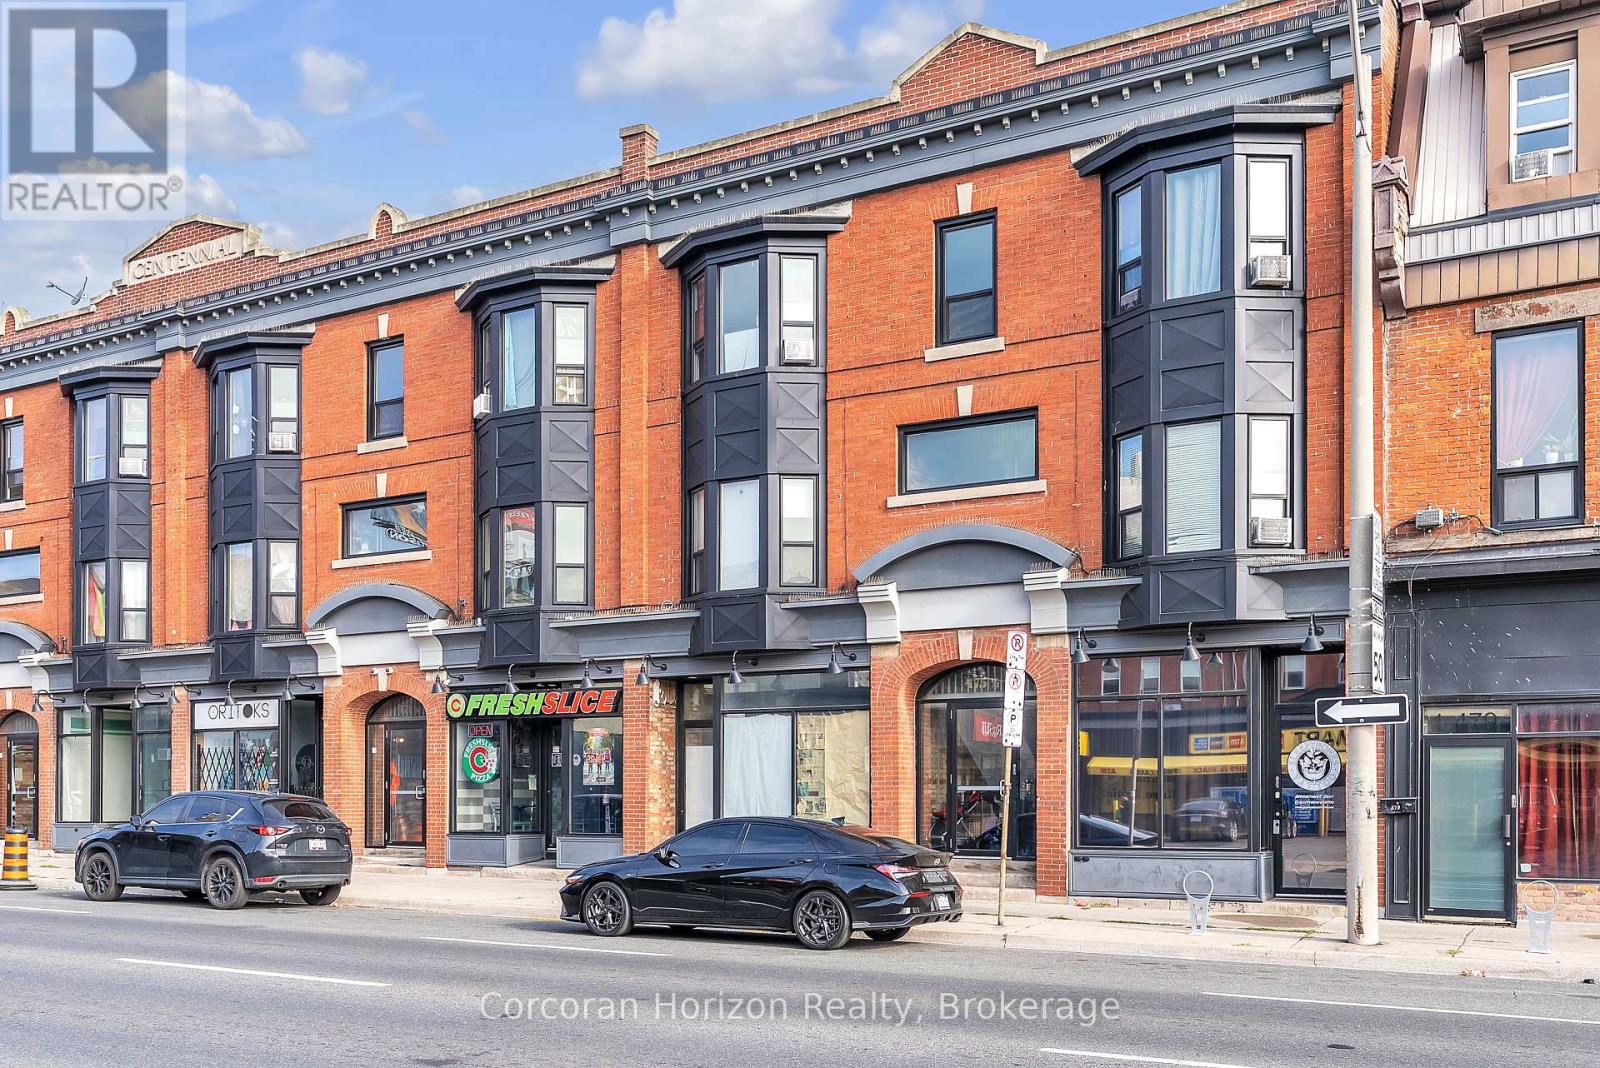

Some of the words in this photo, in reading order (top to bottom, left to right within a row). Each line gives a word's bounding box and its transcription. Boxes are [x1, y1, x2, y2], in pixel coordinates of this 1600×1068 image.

[133, 239, 236, 280] CENTENNIAL
[208, 702, 269, 720] ORITOKS
[465, 689, 617, 717] FRESHSLICE
[470, 726, 492, 736] OPEN
[470, 773, 492, 782] PIZZA
